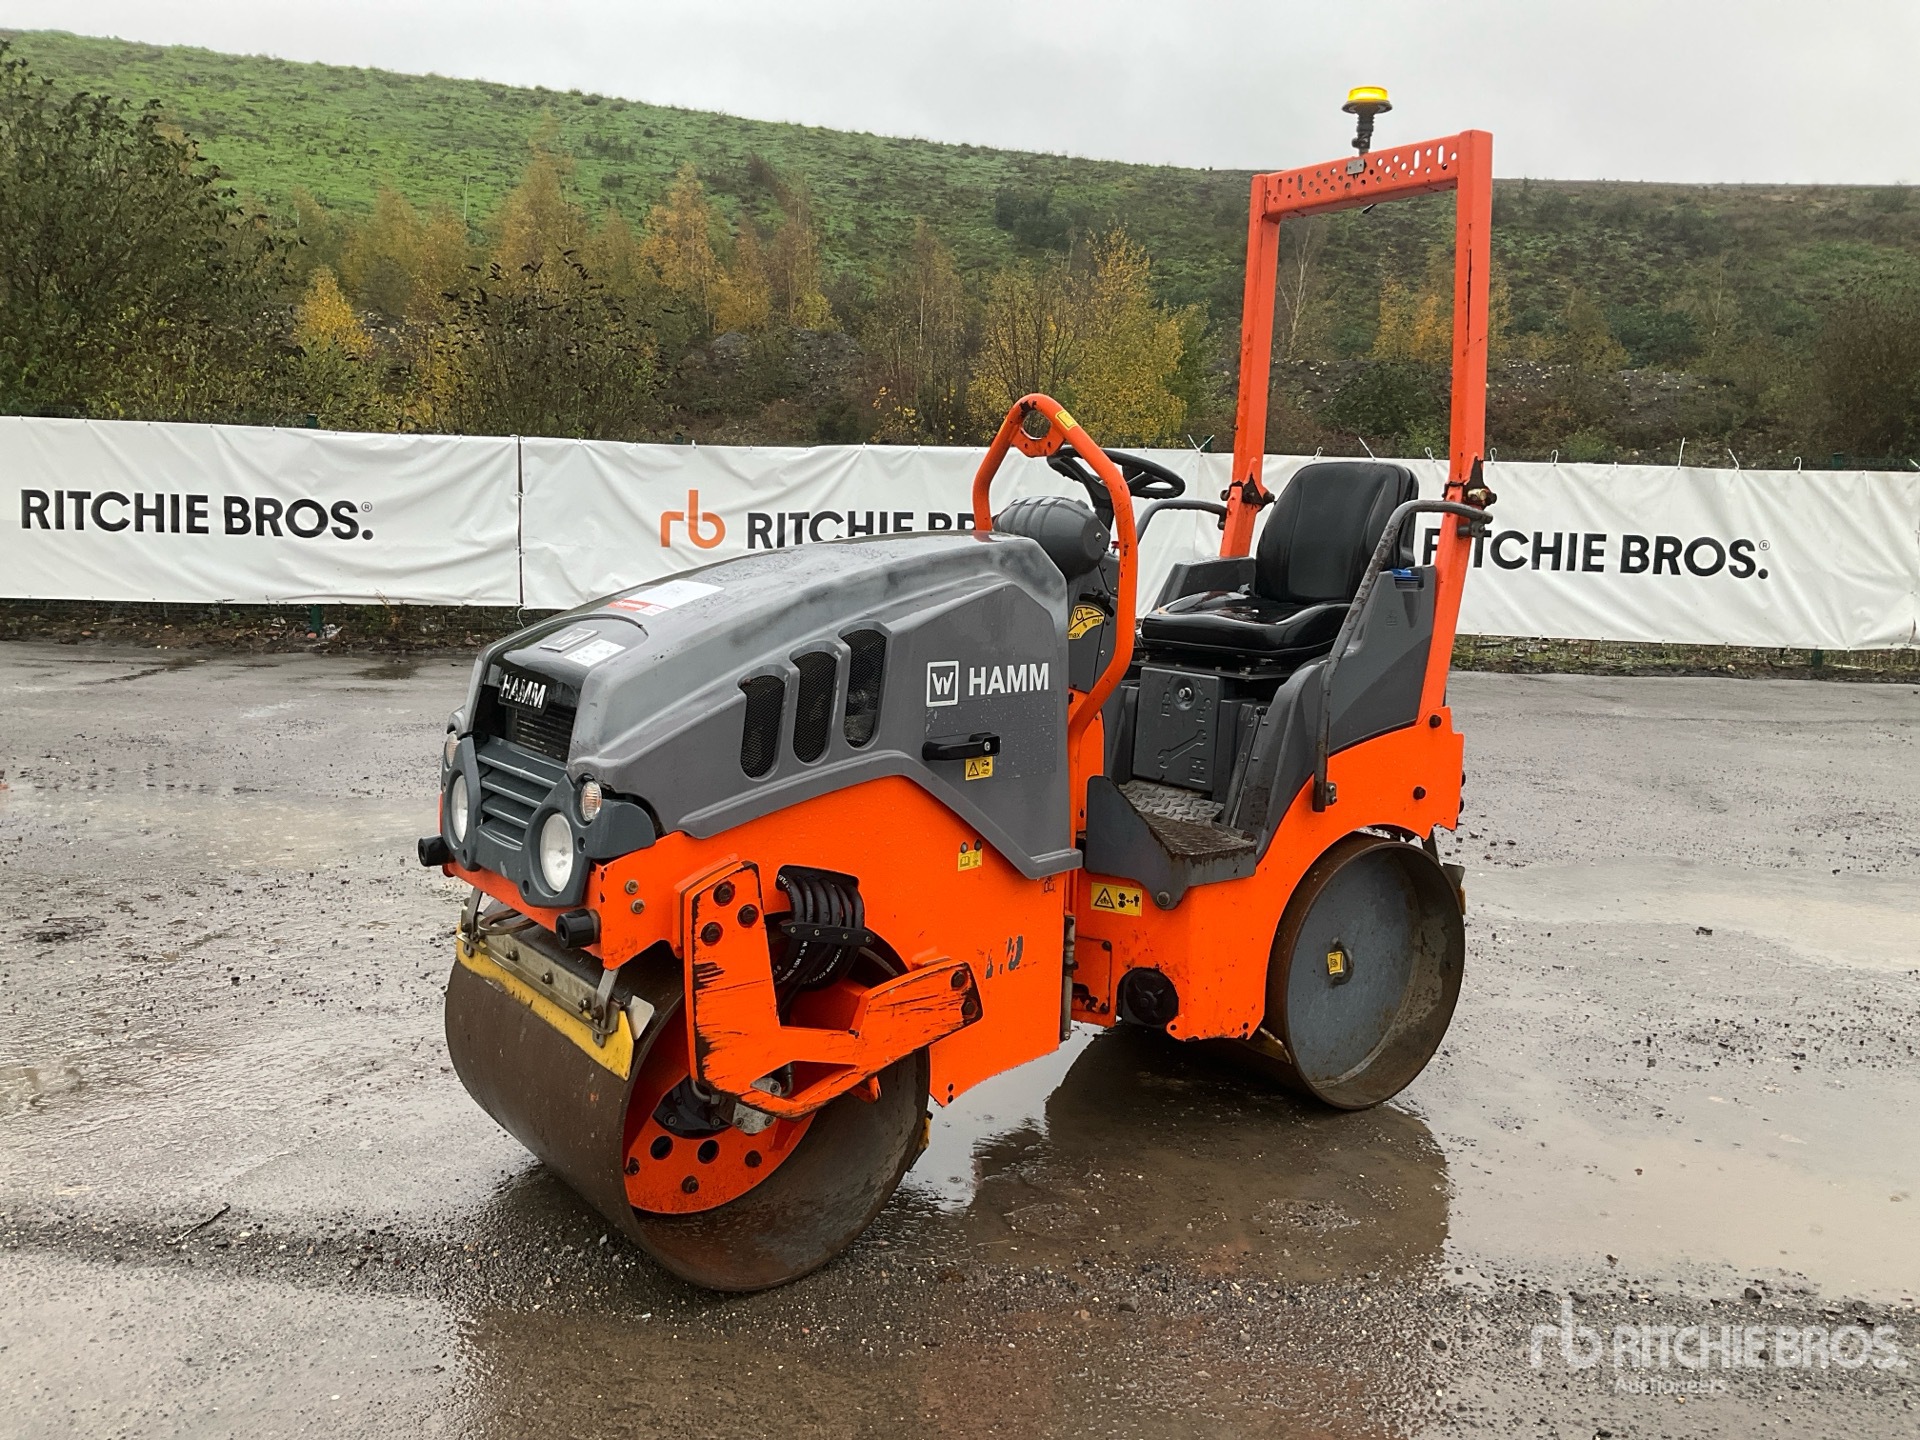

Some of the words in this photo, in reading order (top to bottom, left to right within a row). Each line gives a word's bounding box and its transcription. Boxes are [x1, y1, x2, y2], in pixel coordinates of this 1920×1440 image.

[20, 488, 209, 535] RITCHIE
[747, 510, 914, 549] RITCHIE
[1422, 527, 1608, 572] TCHIE
[500, 674, 547, 709] HAMM
[968, 662, 1049, 696] HAMM
